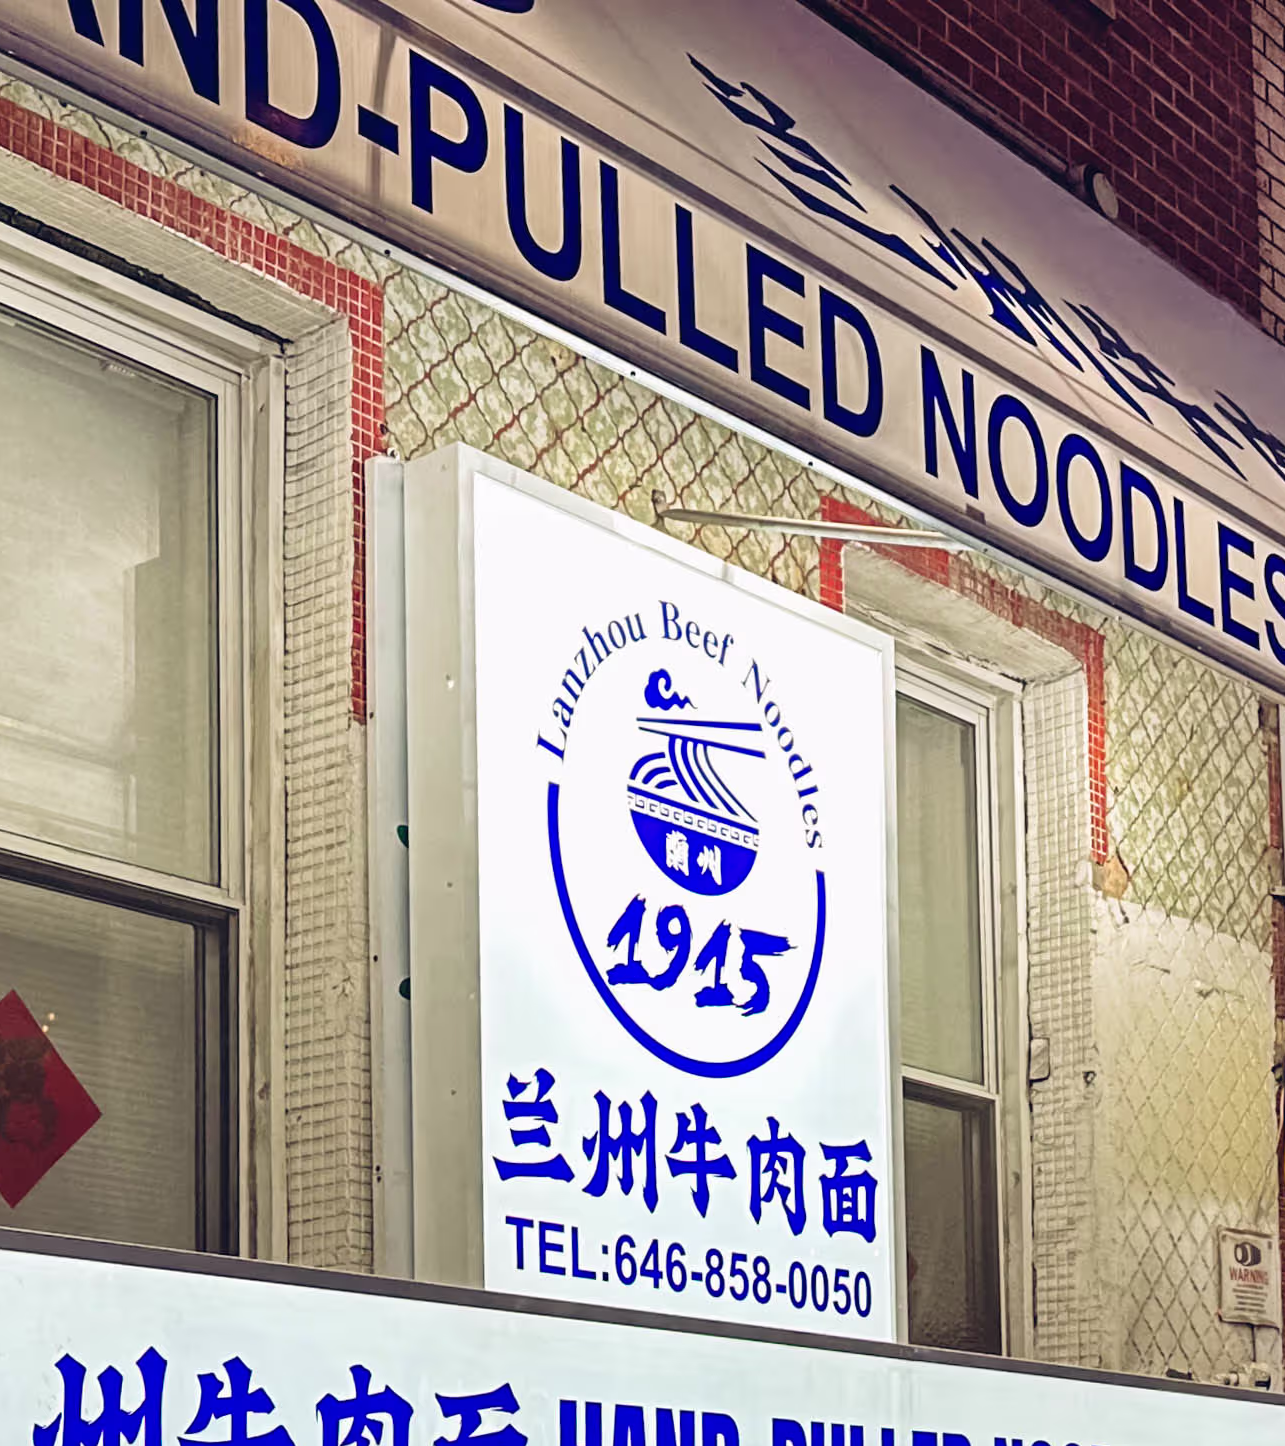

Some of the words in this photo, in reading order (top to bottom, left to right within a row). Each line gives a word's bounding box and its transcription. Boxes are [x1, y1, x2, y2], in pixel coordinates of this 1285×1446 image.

[69, 0, 883, 437] ND-PULLED
[537, 611, 648, 763] Lanzhou
[659, 601, 735, 668] Beef
[741, 658, 824, 850] Noodles
[606, 894, 798, 1017] 1915
[492, 1067, 880, 1244] 兰州牛肉面
[505, 1214, 873, 1319] TEL:646-858-0050
[1229, 1267, 1269, 1286] WARNING
